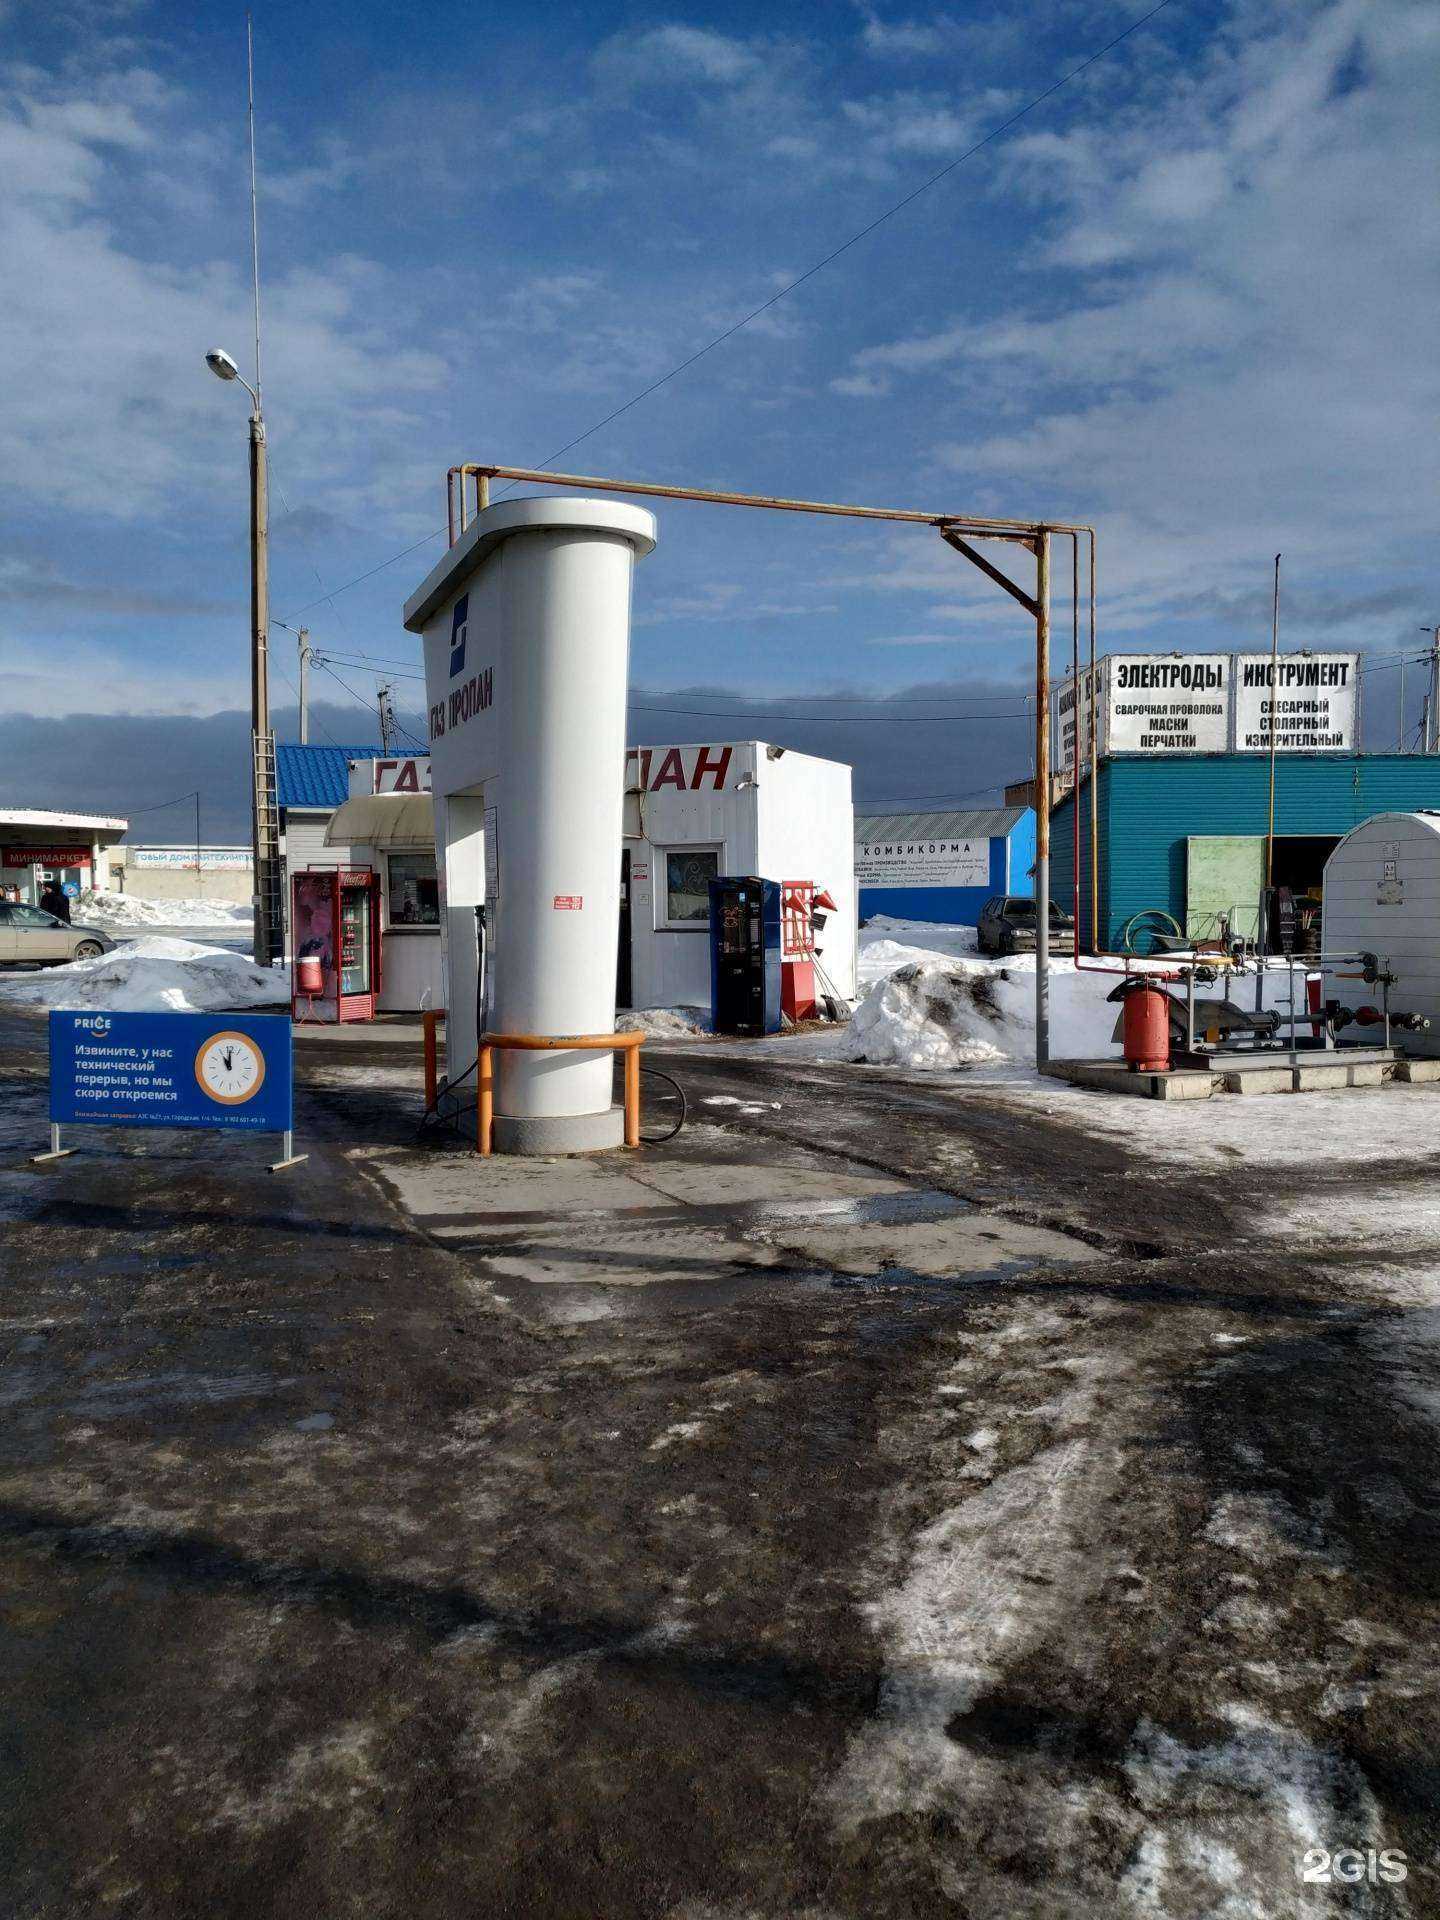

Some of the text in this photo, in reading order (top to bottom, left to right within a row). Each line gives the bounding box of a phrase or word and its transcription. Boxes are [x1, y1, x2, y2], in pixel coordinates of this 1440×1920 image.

[1118, 664, 1222, 691] ЭЛЕКТРОДЫ
[1244, 663, 1349, 687] ИНСТРУМЕНТ
[430, 666, 493, 742] ГАЗ ПРОПАН
[1115, 704, 1223, 715] СВАРОЧНАЯ ПРОВОЛОКА
[1260, 699, 1330, 714] СЛЕСАРНЫЙ
[1149, 718, 1188, 731] МАСКИ
[1260, 715, 1330, 730] СТОЛЯРНЫЙ
[1140, 735, 1197, 748] ПЕРЧАТКИ
[1245, 731, 1344, 747] ИЗМЕРИТЕЛЬНЫЙ
[864, 843, 971, 856] КОМБИКОРМА
[10, 854, 87, 863] МИНИМАРКЕТ
[75, 1016, 111, 1029] PRICE
[75, 1045, 173, 1059] Извините, у нас
[75, 1060, 156, 1071] технический
[75, 1075, 173, 1087] перерыв, но мы
[75, 1089, 178, 1102] скоро откроемся
